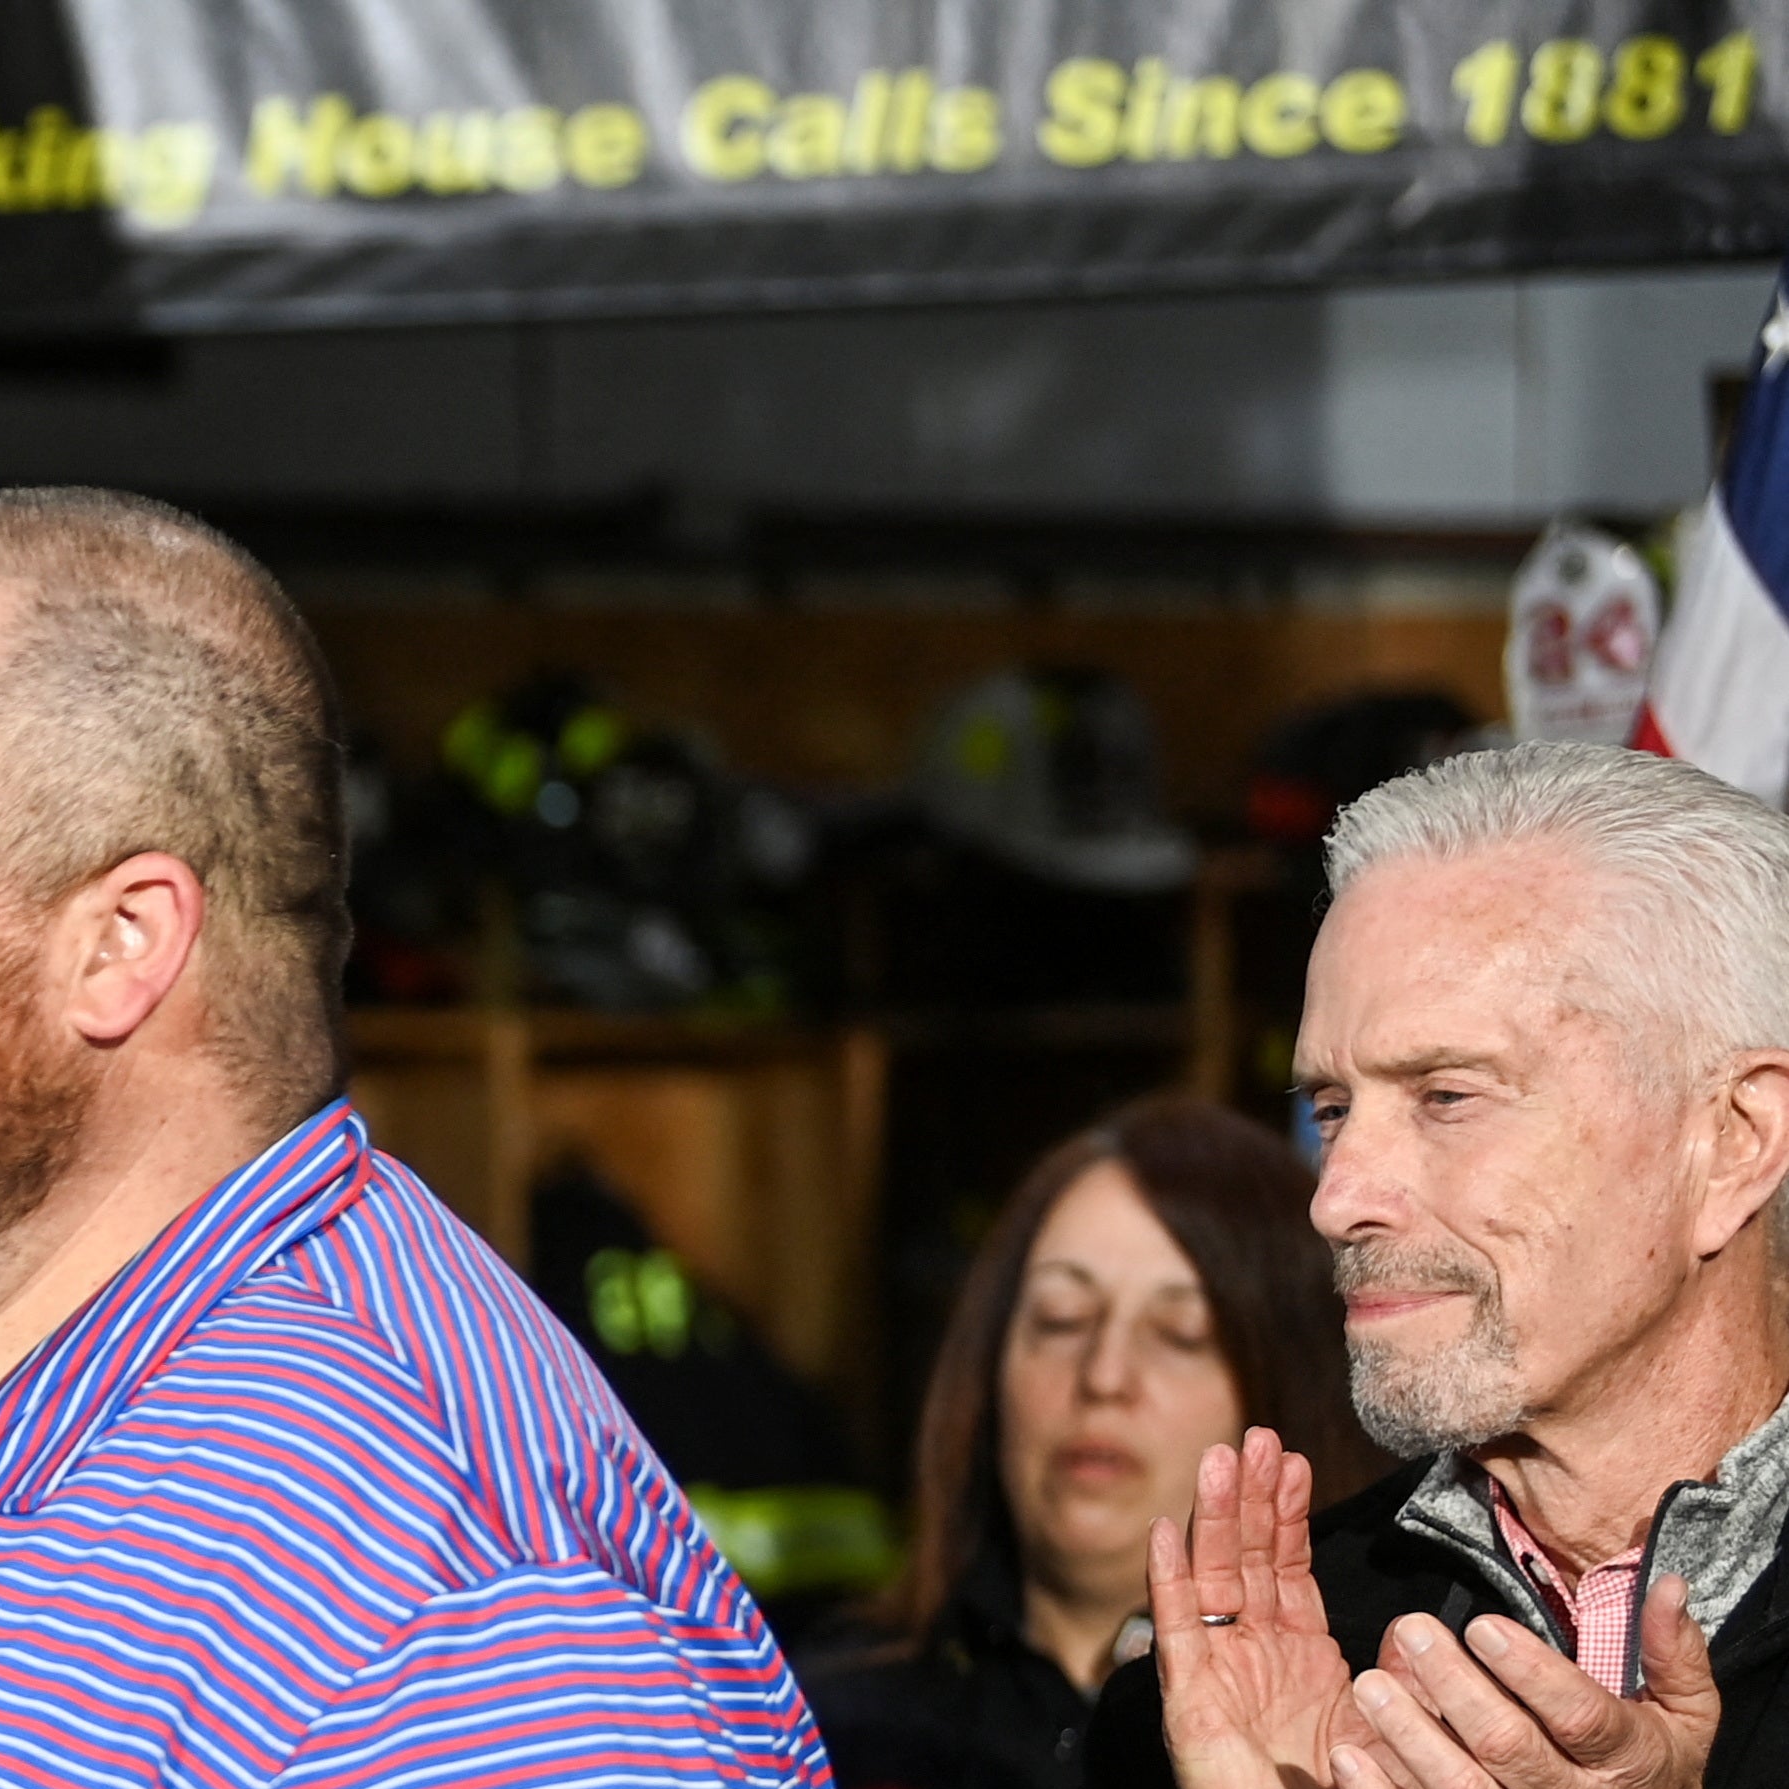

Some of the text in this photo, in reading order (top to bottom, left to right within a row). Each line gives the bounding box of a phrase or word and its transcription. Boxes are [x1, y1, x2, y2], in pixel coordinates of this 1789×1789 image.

[244, 93, 649, 197] House
[679, 66, 1002, 183] Calls
[1036, 56, 1406, 168] Since
[1450, 30, 1758, 147] 1881
